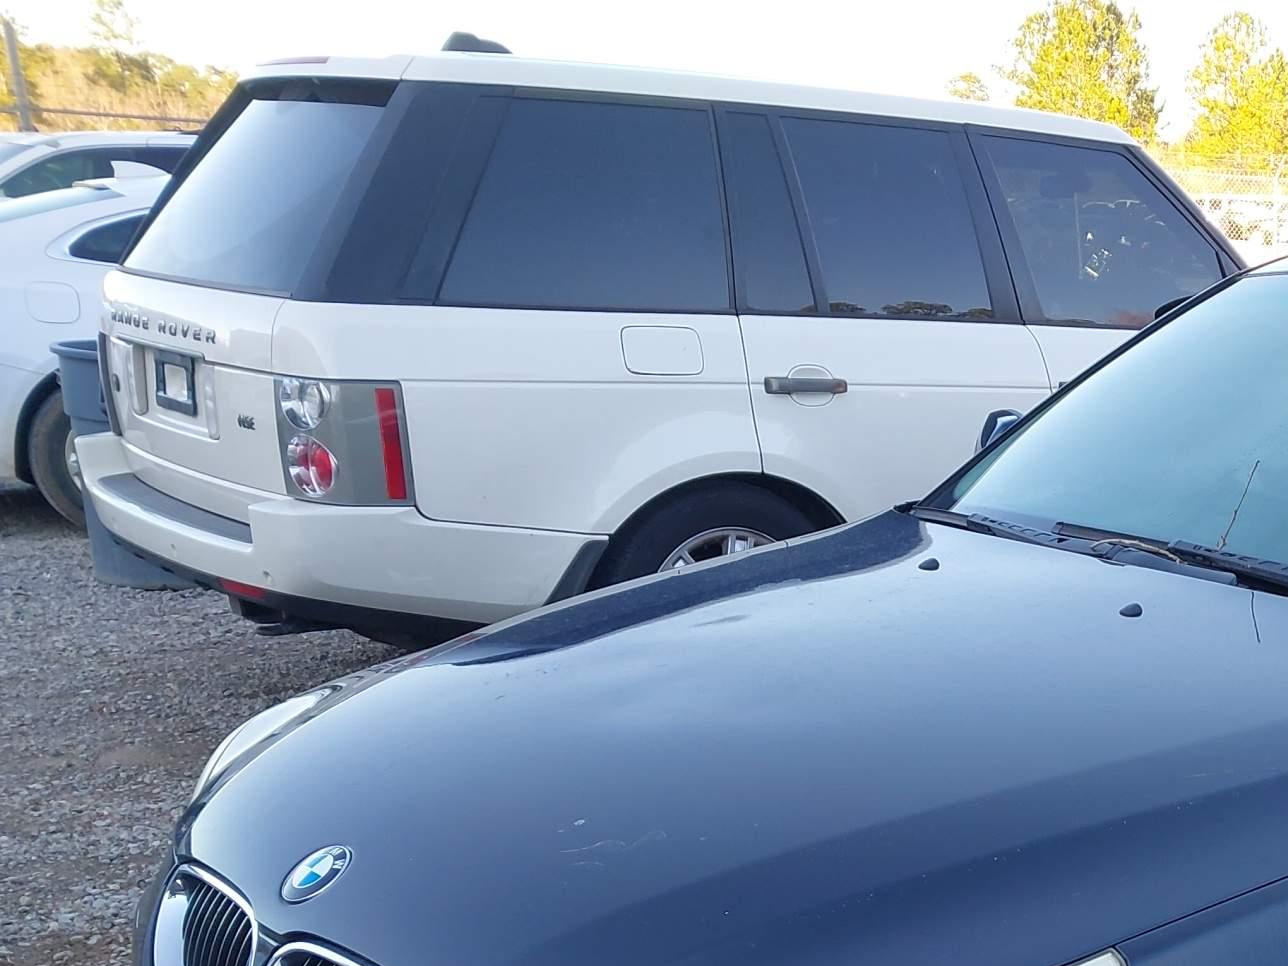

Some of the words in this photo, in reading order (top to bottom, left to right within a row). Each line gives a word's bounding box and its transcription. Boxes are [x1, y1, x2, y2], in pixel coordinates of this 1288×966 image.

[112, 311, 150, 330] RANGE
[158, 320, 216, 345] ROVER
[237, 414, 256, 431] HSE
